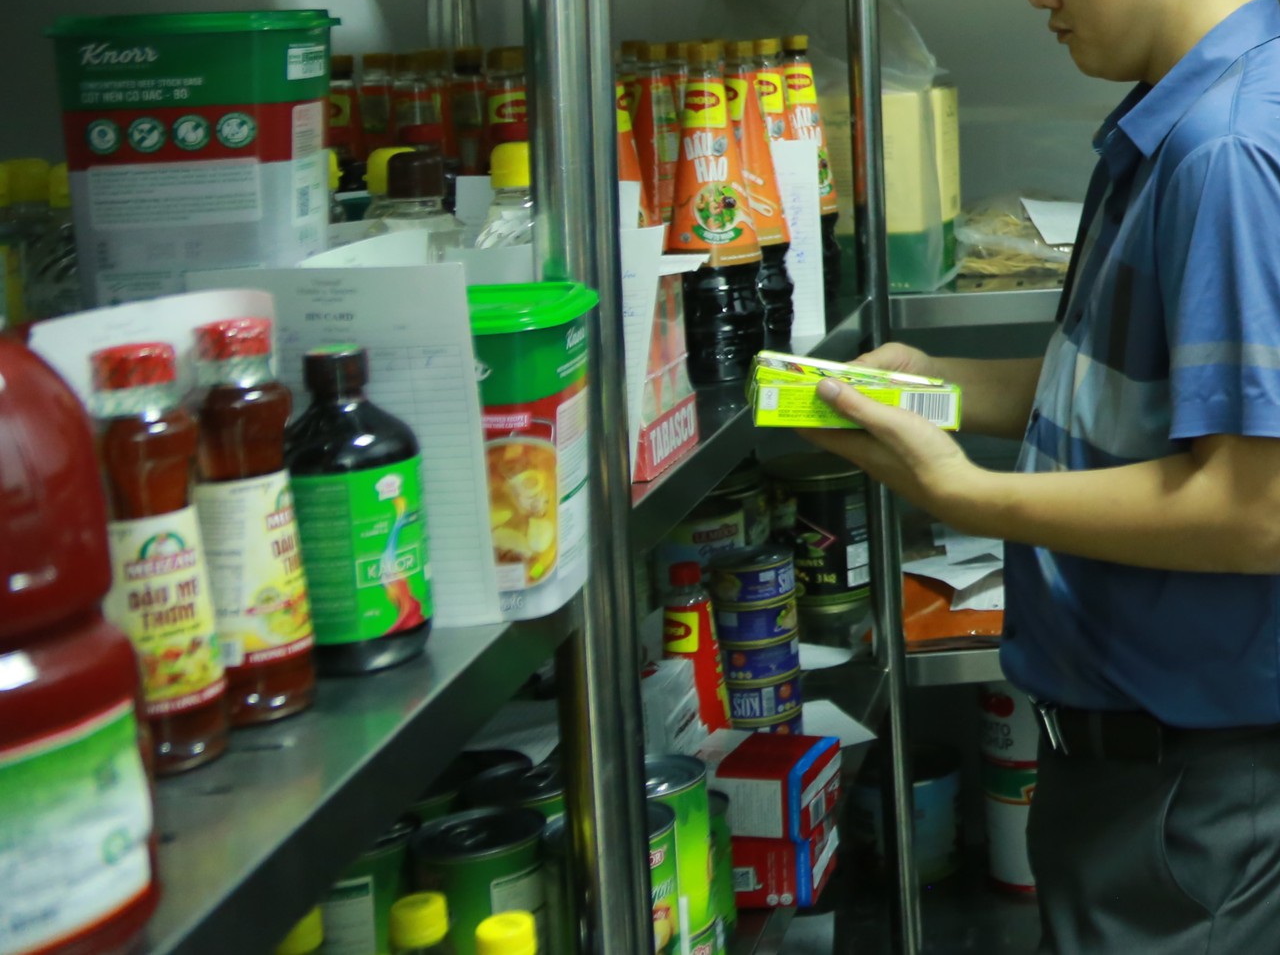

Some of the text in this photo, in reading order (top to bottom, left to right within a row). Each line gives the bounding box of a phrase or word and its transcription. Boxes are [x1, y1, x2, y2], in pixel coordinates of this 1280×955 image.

[79, 42, 159, 66] Knorr
[324, 312, 354, 322] CARD
[650, 401, 696, 467] TABASCO
[733, 697, 761, 718] KOS
